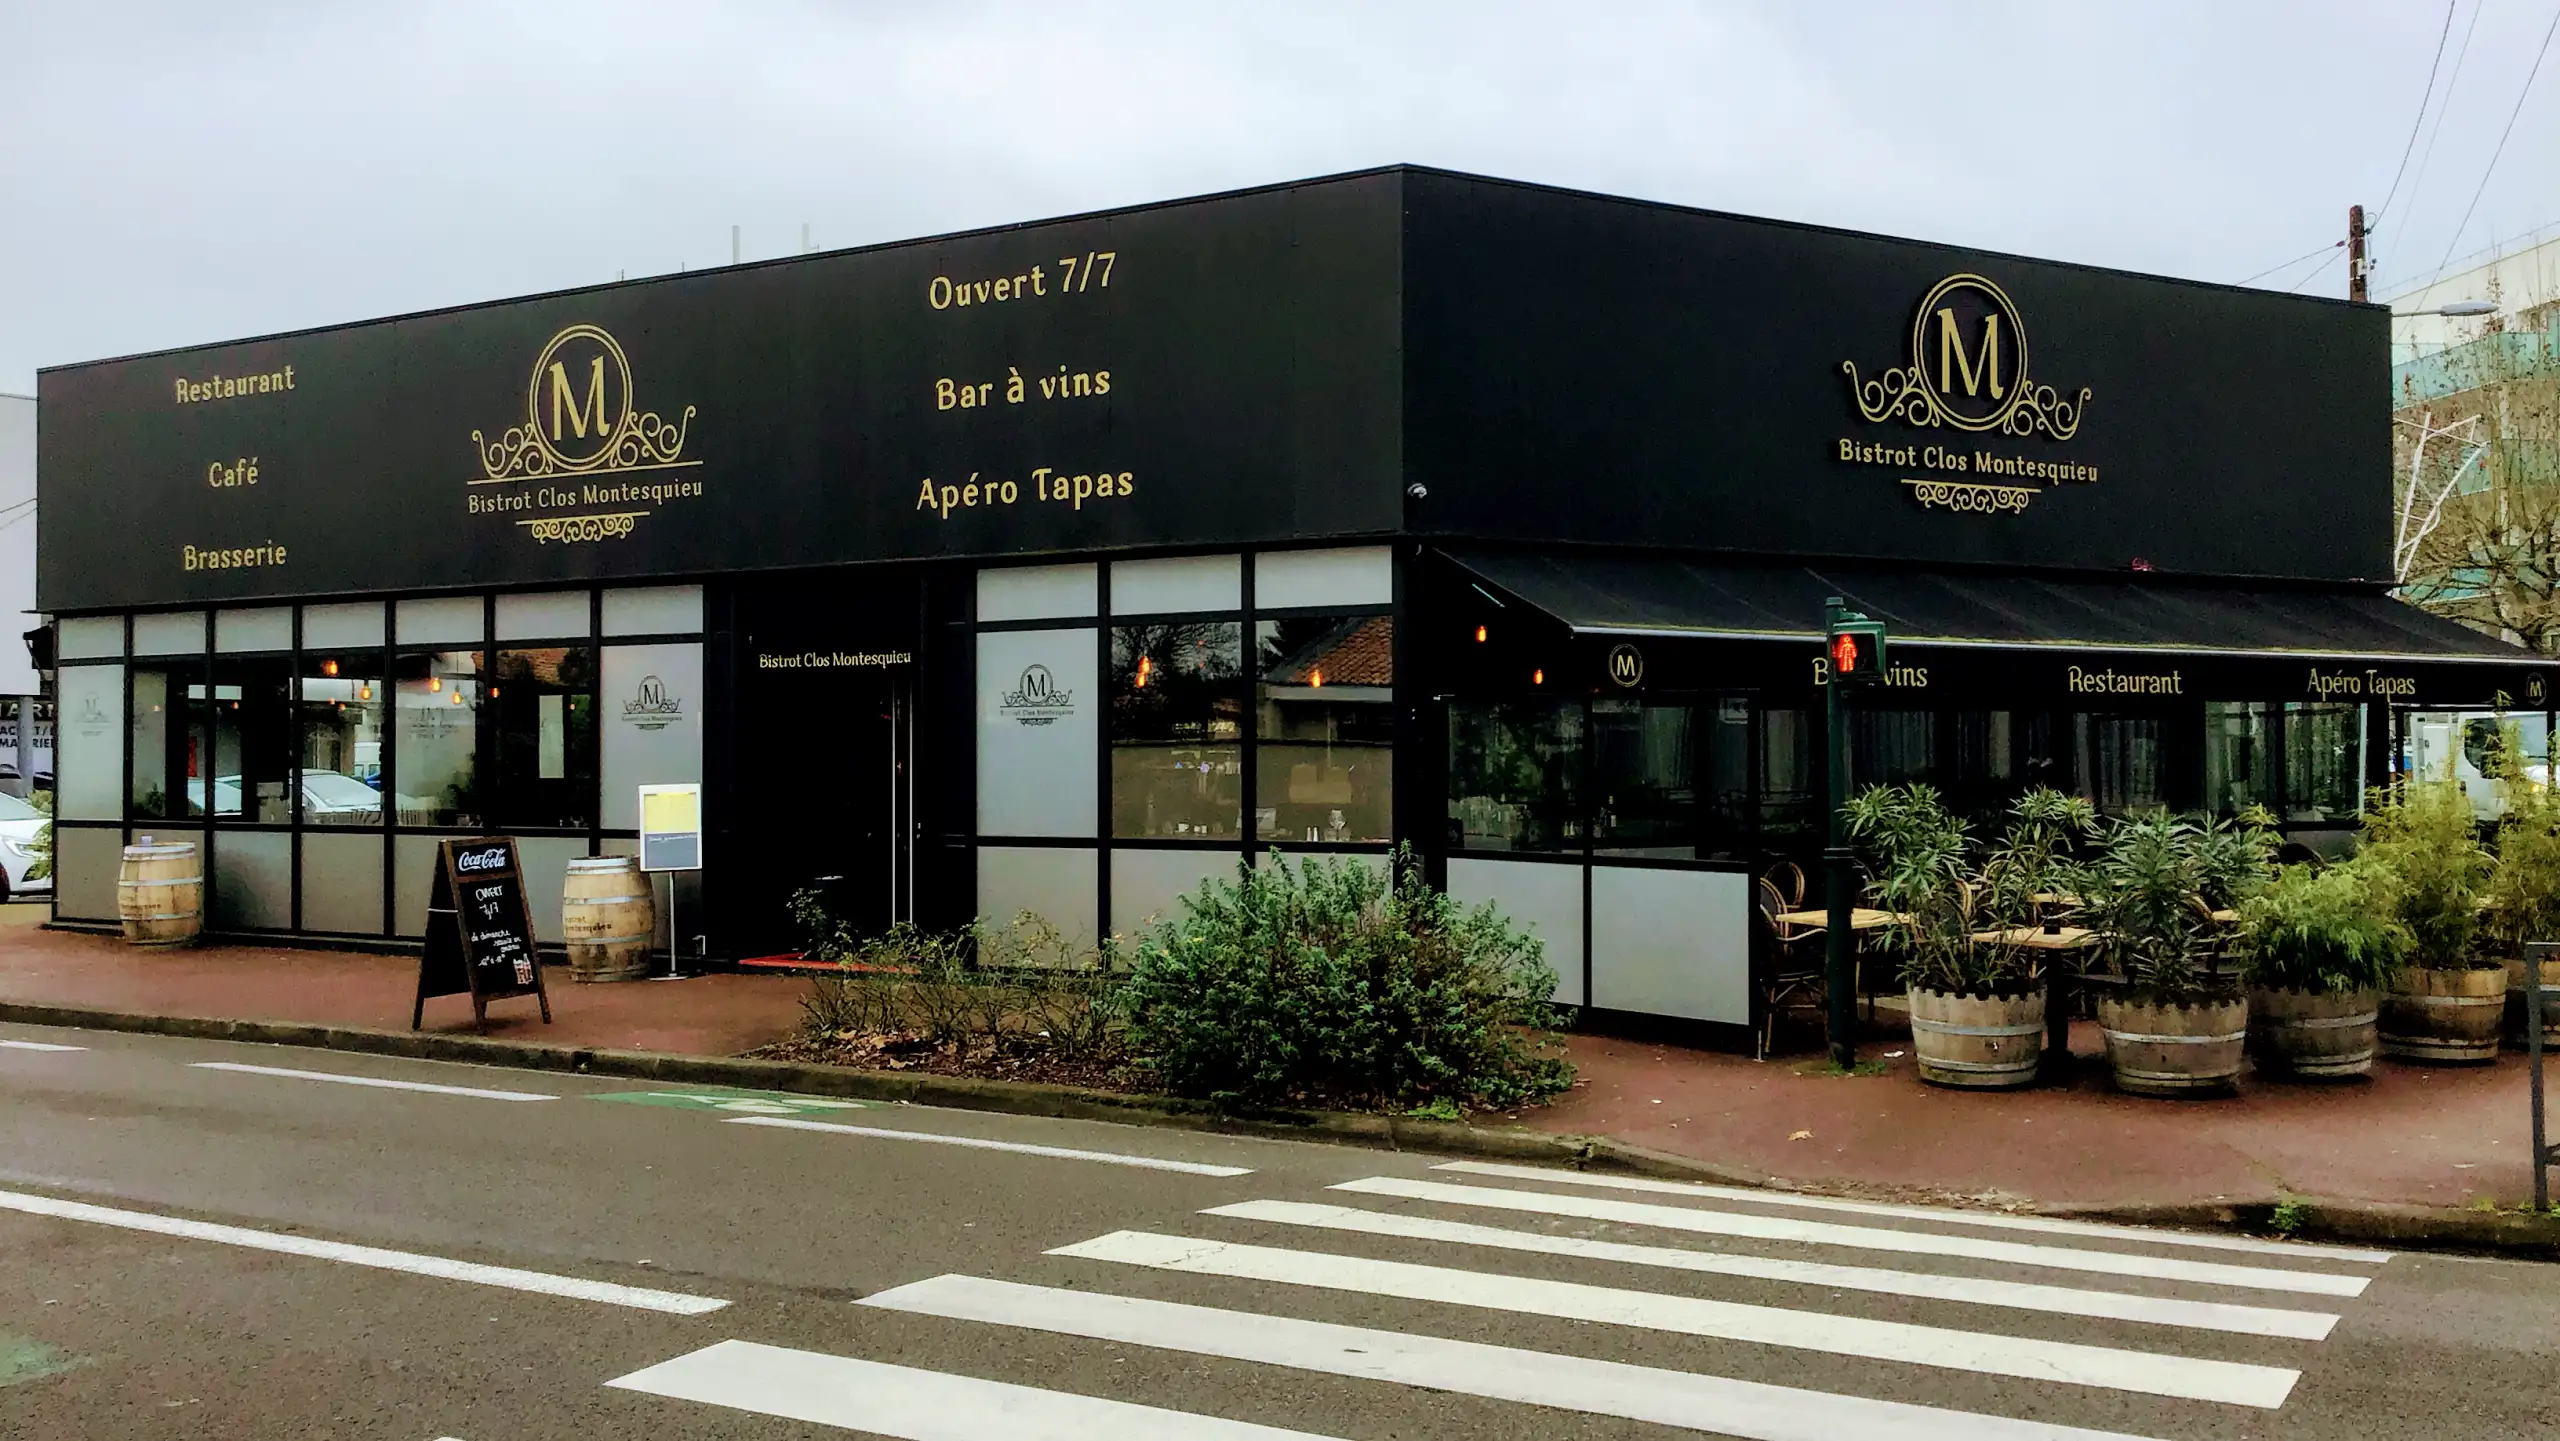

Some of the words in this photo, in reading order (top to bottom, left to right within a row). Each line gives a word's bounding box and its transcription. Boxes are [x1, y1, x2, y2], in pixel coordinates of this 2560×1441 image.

[929, 264, 1047, 310] Ouvert
[1058, 251, 1116, 293] 7/7
[1937, 307, 2004, 400] M
[175, 365, 295, 404] Restaurant
[549, 355, 610, 441] M
[935, 378, 993, 411] Bar
[1006, 366, 1025, 404] à
[1038, 364, 1111, 400] vins
[208, 456, 259, 488] Café
[1839, 438, 1917, 467] Bistrot
[1923, 446, 1968, 471] Clos
[1975, 451, 2098, 486] Montesquieu
[468, 491, 532, 514] Bistrot
[538, 486, 577, 508] Clos
[583, 478, 702, 506] Montesquieu
[916, 472, 1018, 520] Apéro
[1031, 467, 1133, 511] Tapas
[183, 539, 287, 571] Brasserie
[759, 653, 802, 669] Bistrot
[803, 652, 831, 668] Clos
[832, 650, 911, 670] Montesquieu
[1616, 654, 1636, 677] M
[1884, 660, 1928, 687] vins
[2067, 665, 2183, 695] Restaurant
[2307, 667, 2361, 702] Apéro
[2365, 669, 2416, 702] Tapas
[458, 848, 507, 872] Coca-Cola
